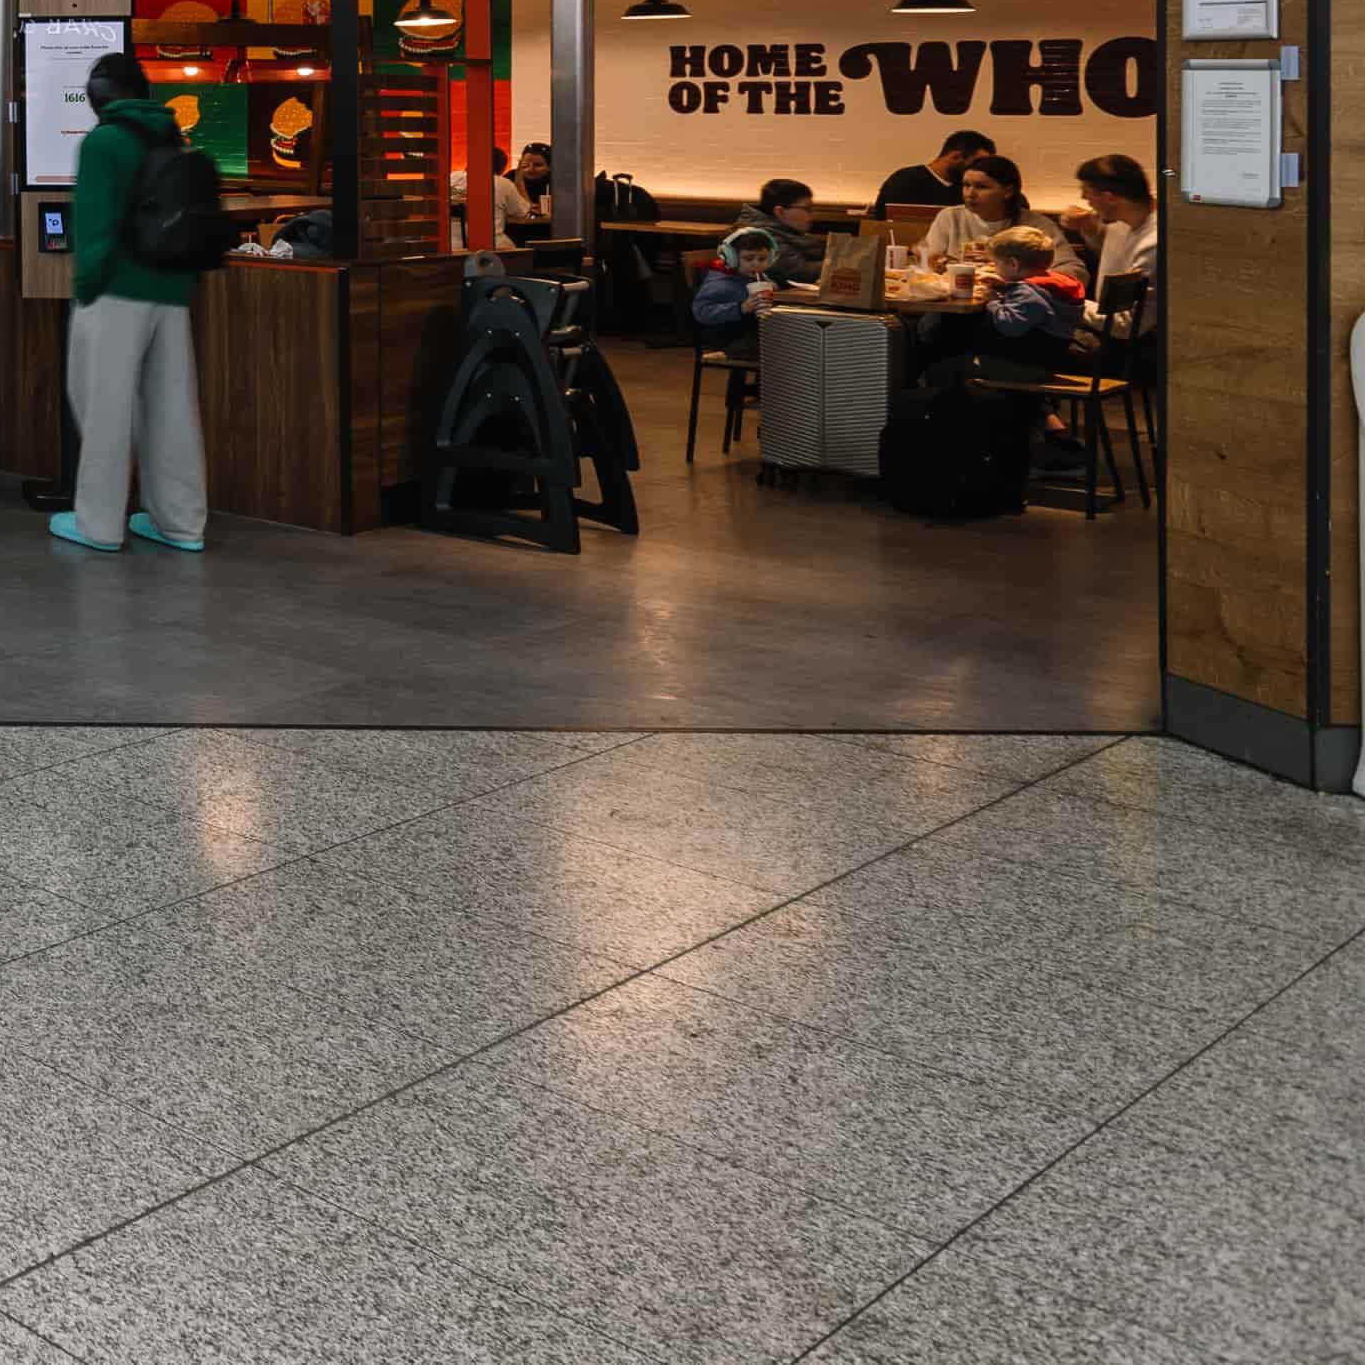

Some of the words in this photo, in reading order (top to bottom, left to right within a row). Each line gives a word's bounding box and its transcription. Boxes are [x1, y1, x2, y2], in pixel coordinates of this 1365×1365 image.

[669, 43, 827, 78] HOME
[837, 36, 1157, 119] WHO
[64, 93, 86, 103] 1616
[668, 81, 730, 116] OF
[738, 81, 846, 116] THE
